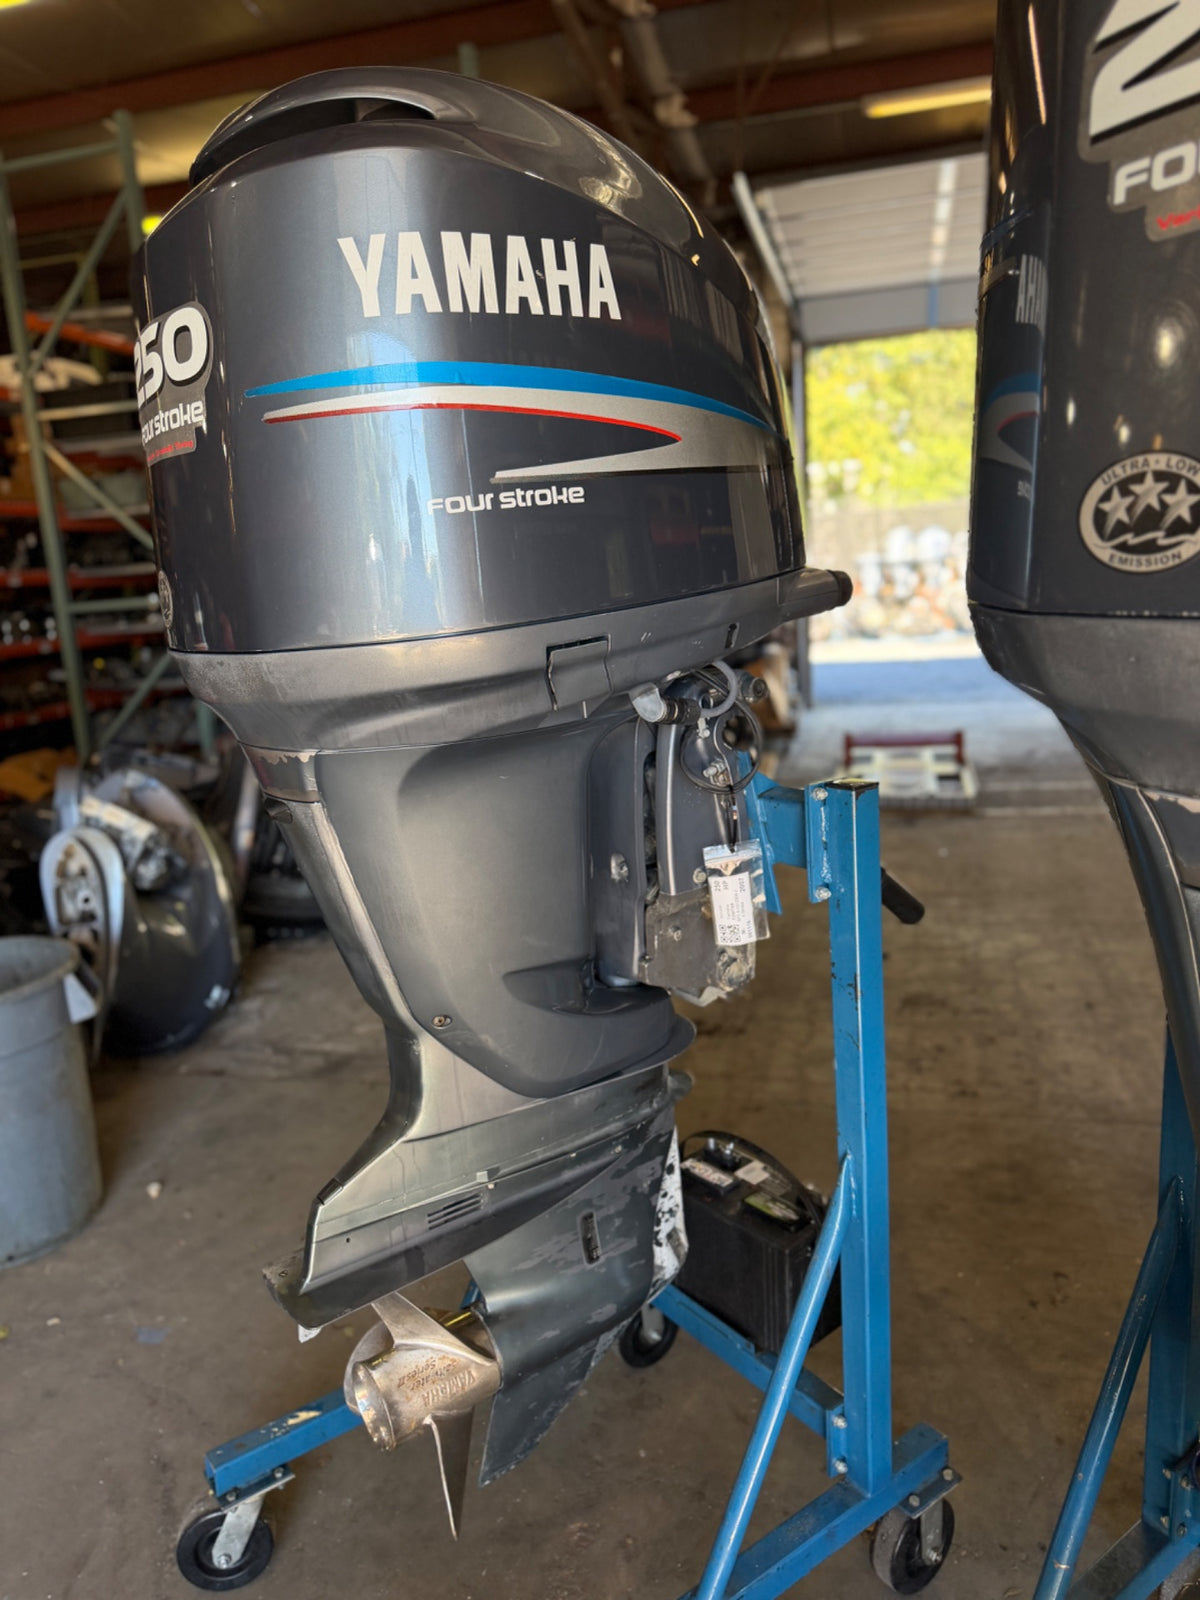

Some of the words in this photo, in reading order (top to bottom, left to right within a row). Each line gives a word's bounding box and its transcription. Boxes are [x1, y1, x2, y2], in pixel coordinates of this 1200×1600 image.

[1113, 141, 1200, 206] FO
[337, 231, 622, 320] YAMAHA
[134, 307, 208, 408] 250
[153, 401, 204, 436] stroke
[1101, 457, 1150, 485] ULTRA
[1166, 457, 1200, 476] LOW
[499, 485, 585, 509] stroke
[1109, 550, 1182, 568] EMISSION
